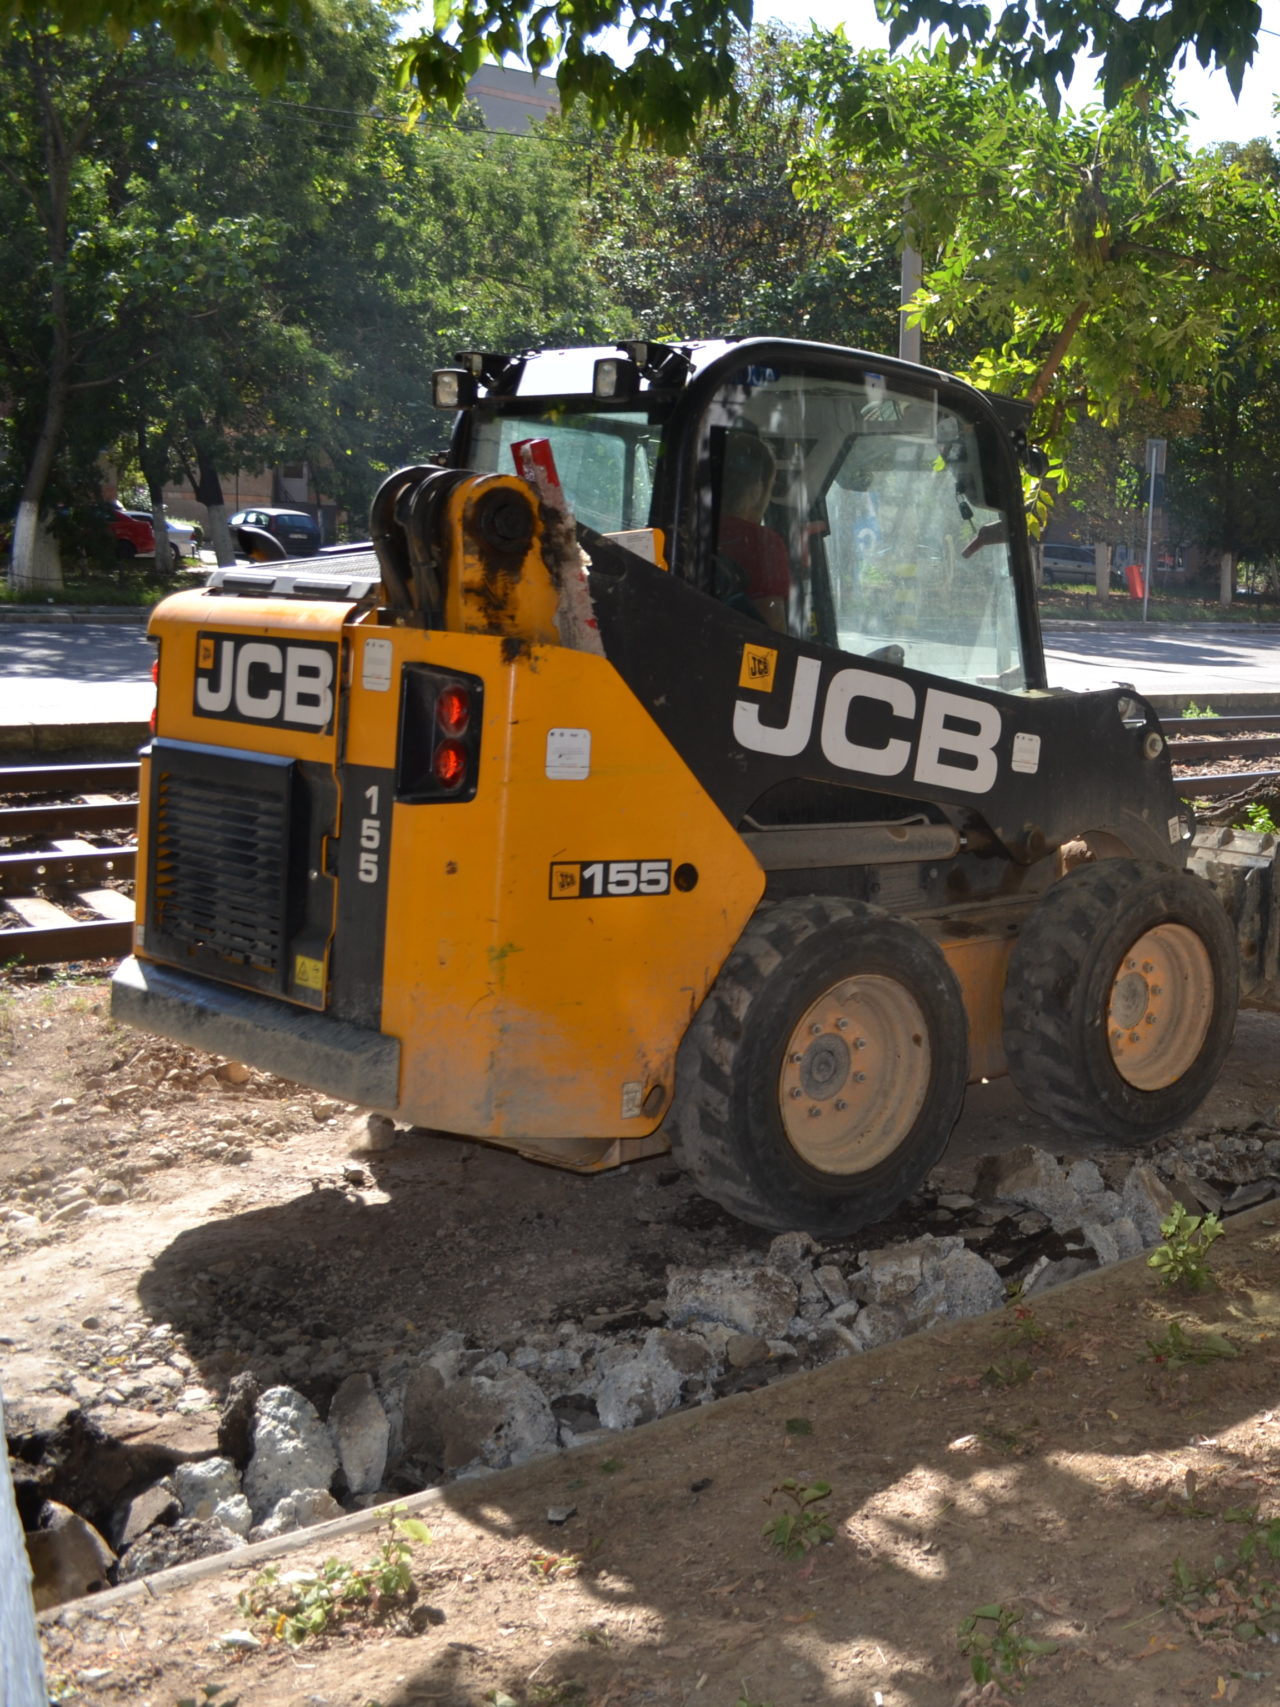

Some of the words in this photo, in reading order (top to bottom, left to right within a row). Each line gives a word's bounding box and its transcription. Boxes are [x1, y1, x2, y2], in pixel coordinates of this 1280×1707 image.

[197, 640, 333, 726] JCB
[733, 656, 1002, 794] JCB
[358, 785, 381, 883] 155
[582, 861, 669, 895] 155
